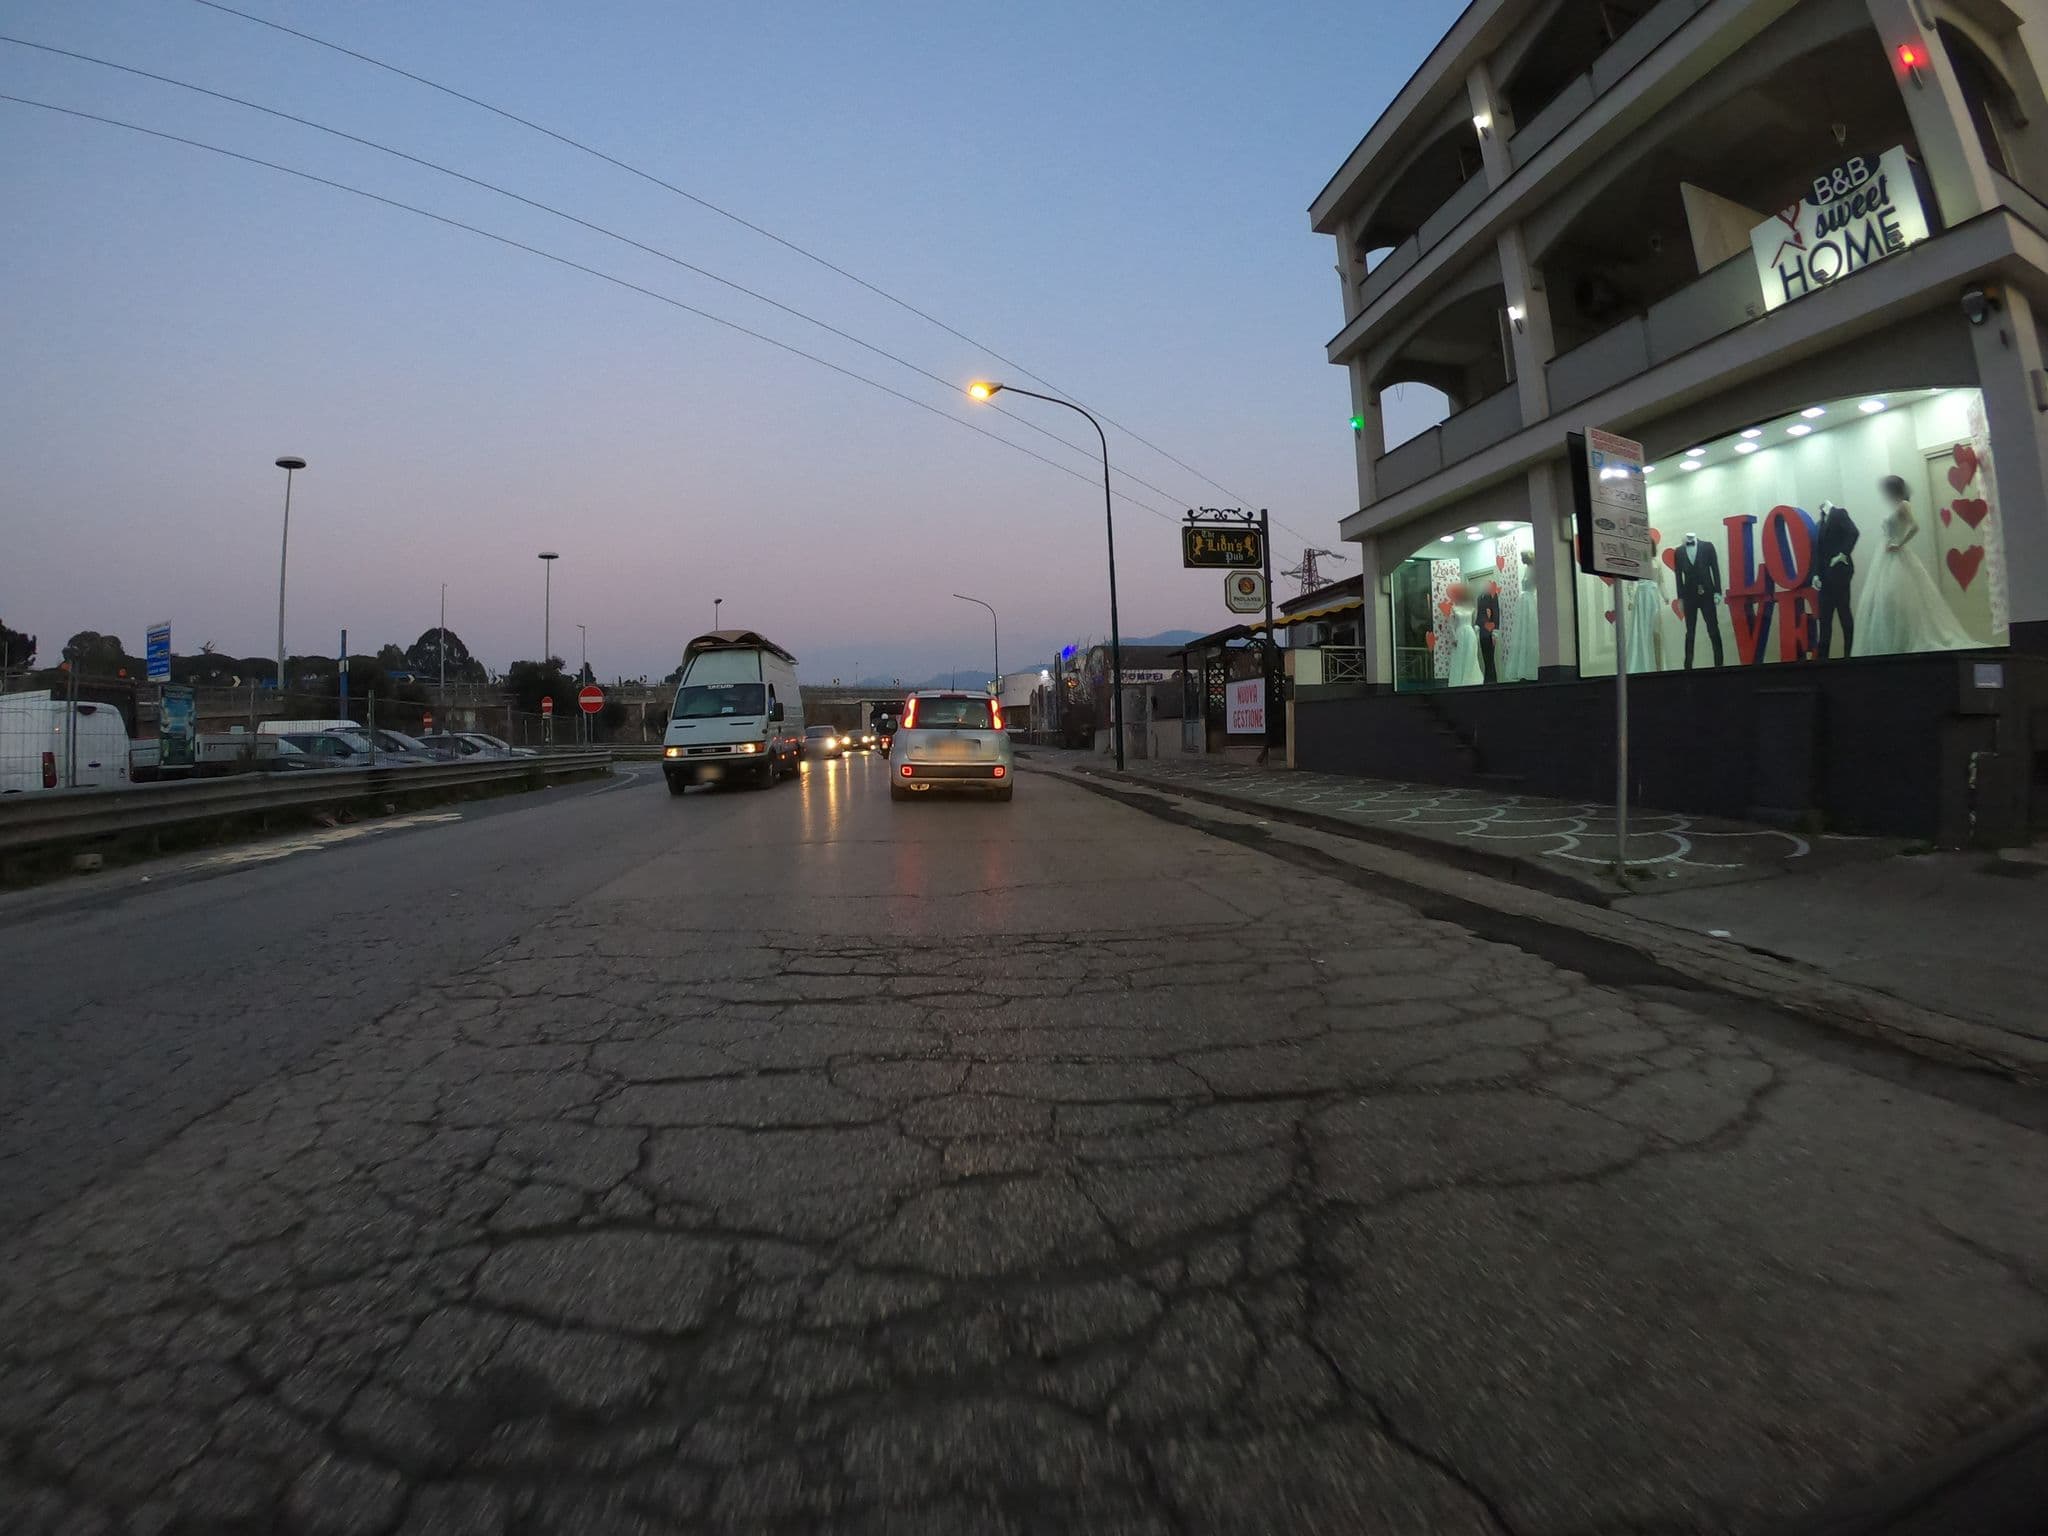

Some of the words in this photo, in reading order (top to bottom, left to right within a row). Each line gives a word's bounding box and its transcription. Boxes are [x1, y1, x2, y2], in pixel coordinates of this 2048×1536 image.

[1813, 156, 1869, 205] B&B
[1815, 174, 1890, 239] sweet
[1779, 206, 1906, 300] HOME
[1206, 534, 1243, 552] Lion's
[1224, 551, 1244, 564] Pub
[1434, 564, 1457, 579] Love
[1237, 683, 1258, 705] NUOVA
[1232, 708, 1264, 729] GESTIONE
